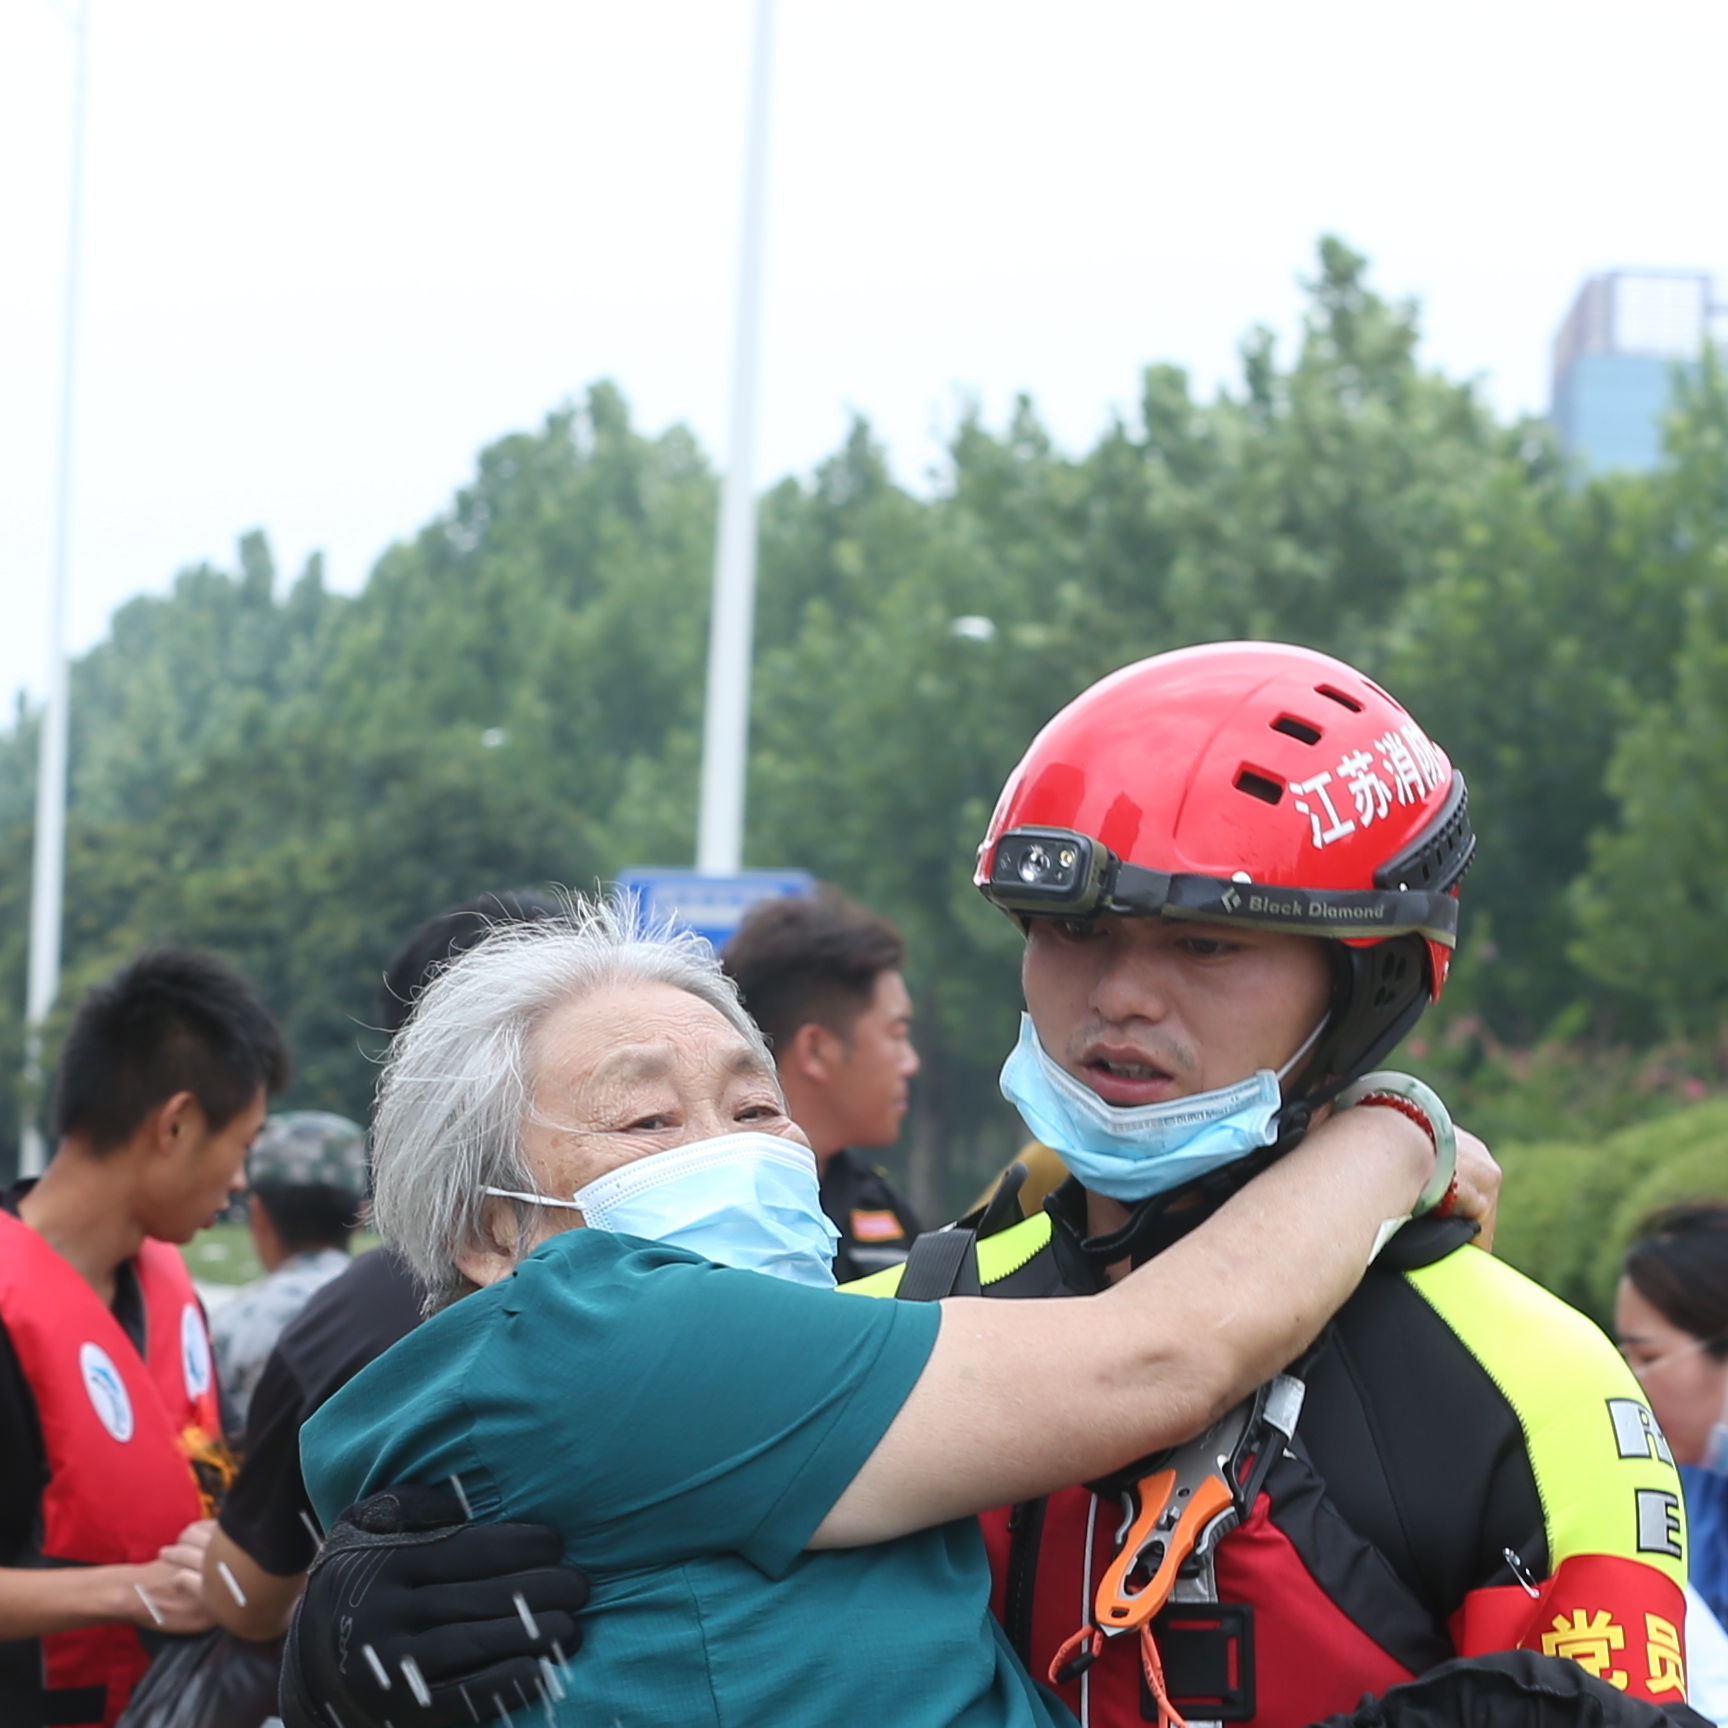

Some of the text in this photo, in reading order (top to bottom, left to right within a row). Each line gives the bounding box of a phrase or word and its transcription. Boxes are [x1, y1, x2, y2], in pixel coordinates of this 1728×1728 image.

[1248, 895, 1385, 919] Black Diamond
[1541, 1608, 1688, 1704] 党员
